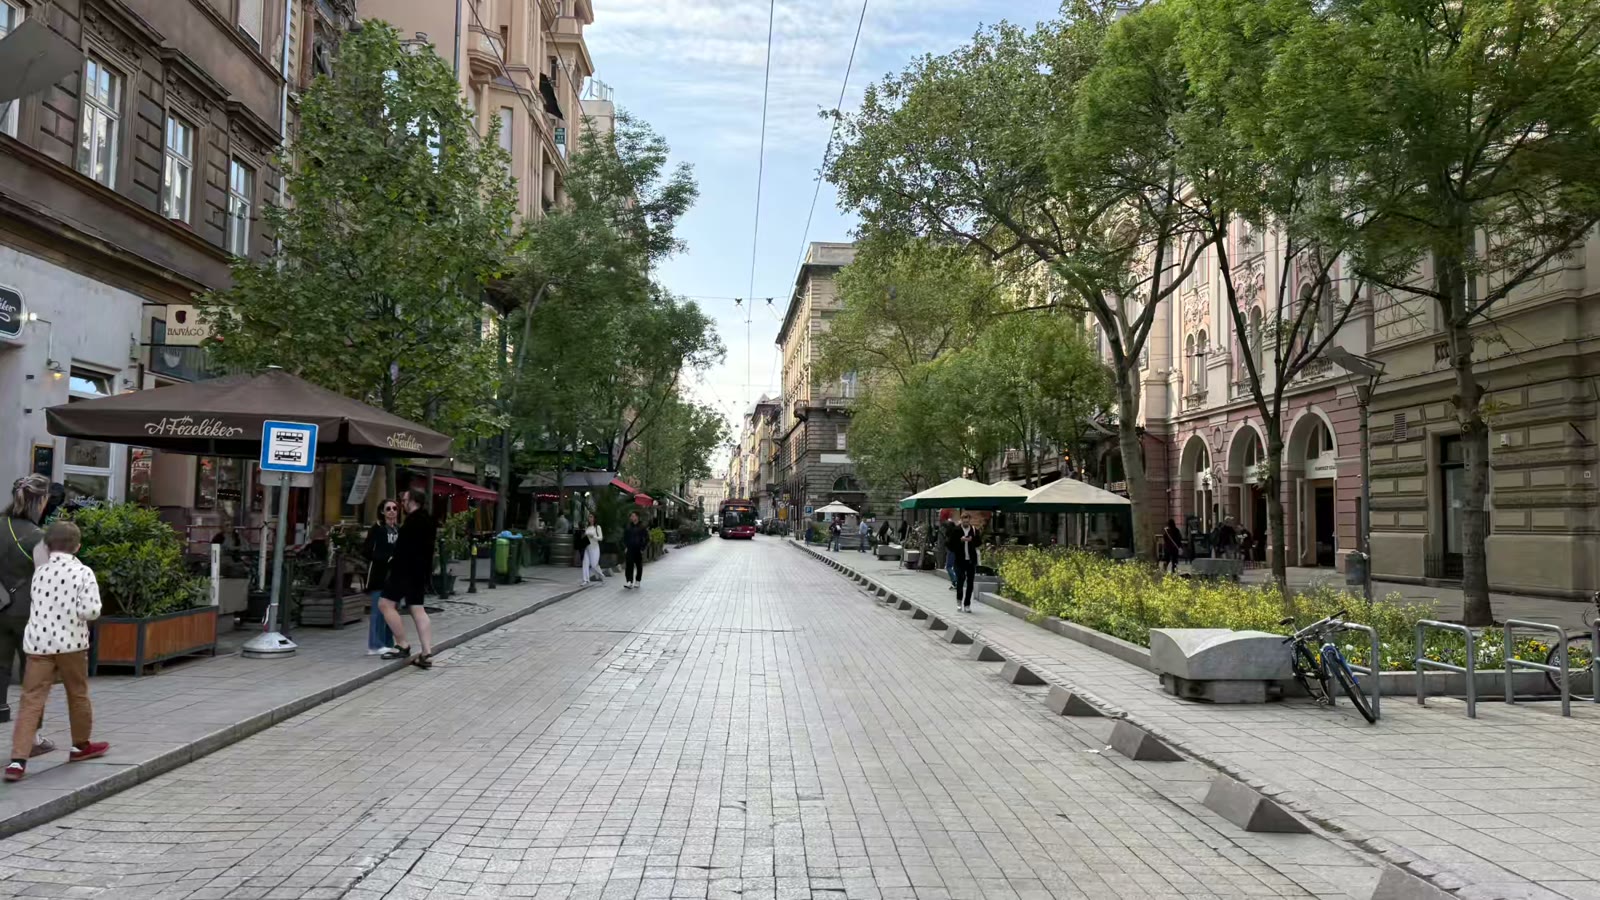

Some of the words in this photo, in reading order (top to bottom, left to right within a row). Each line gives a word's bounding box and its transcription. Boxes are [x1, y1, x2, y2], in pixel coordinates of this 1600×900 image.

[167, 326, 204, 336] HAJVÁGÓ
[144, 417, 167, 435] A
[166, 415, 243, 437] Főzelékes
